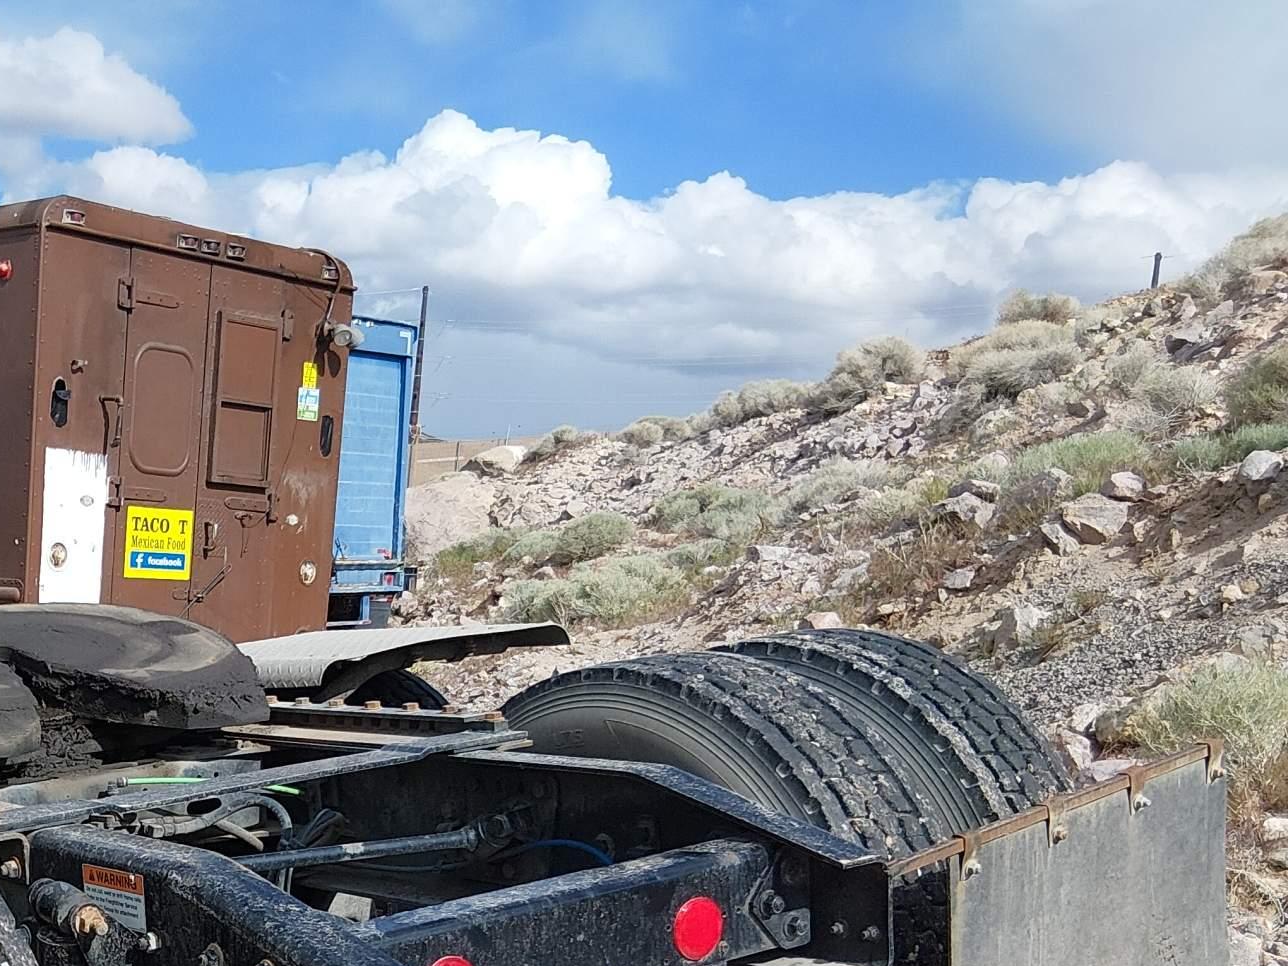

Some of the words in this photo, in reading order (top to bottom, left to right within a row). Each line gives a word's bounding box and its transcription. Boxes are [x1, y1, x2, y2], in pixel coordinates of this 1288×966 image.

[132, 517, 170, 533] TACO
[179, 520, 189, 535] T
[131, 535, 165, 550] Mexican
[167, 537, 186, 551] Food
[147, 556, 182, 567] facebook
[96, 869, 137, 890] WARNING
